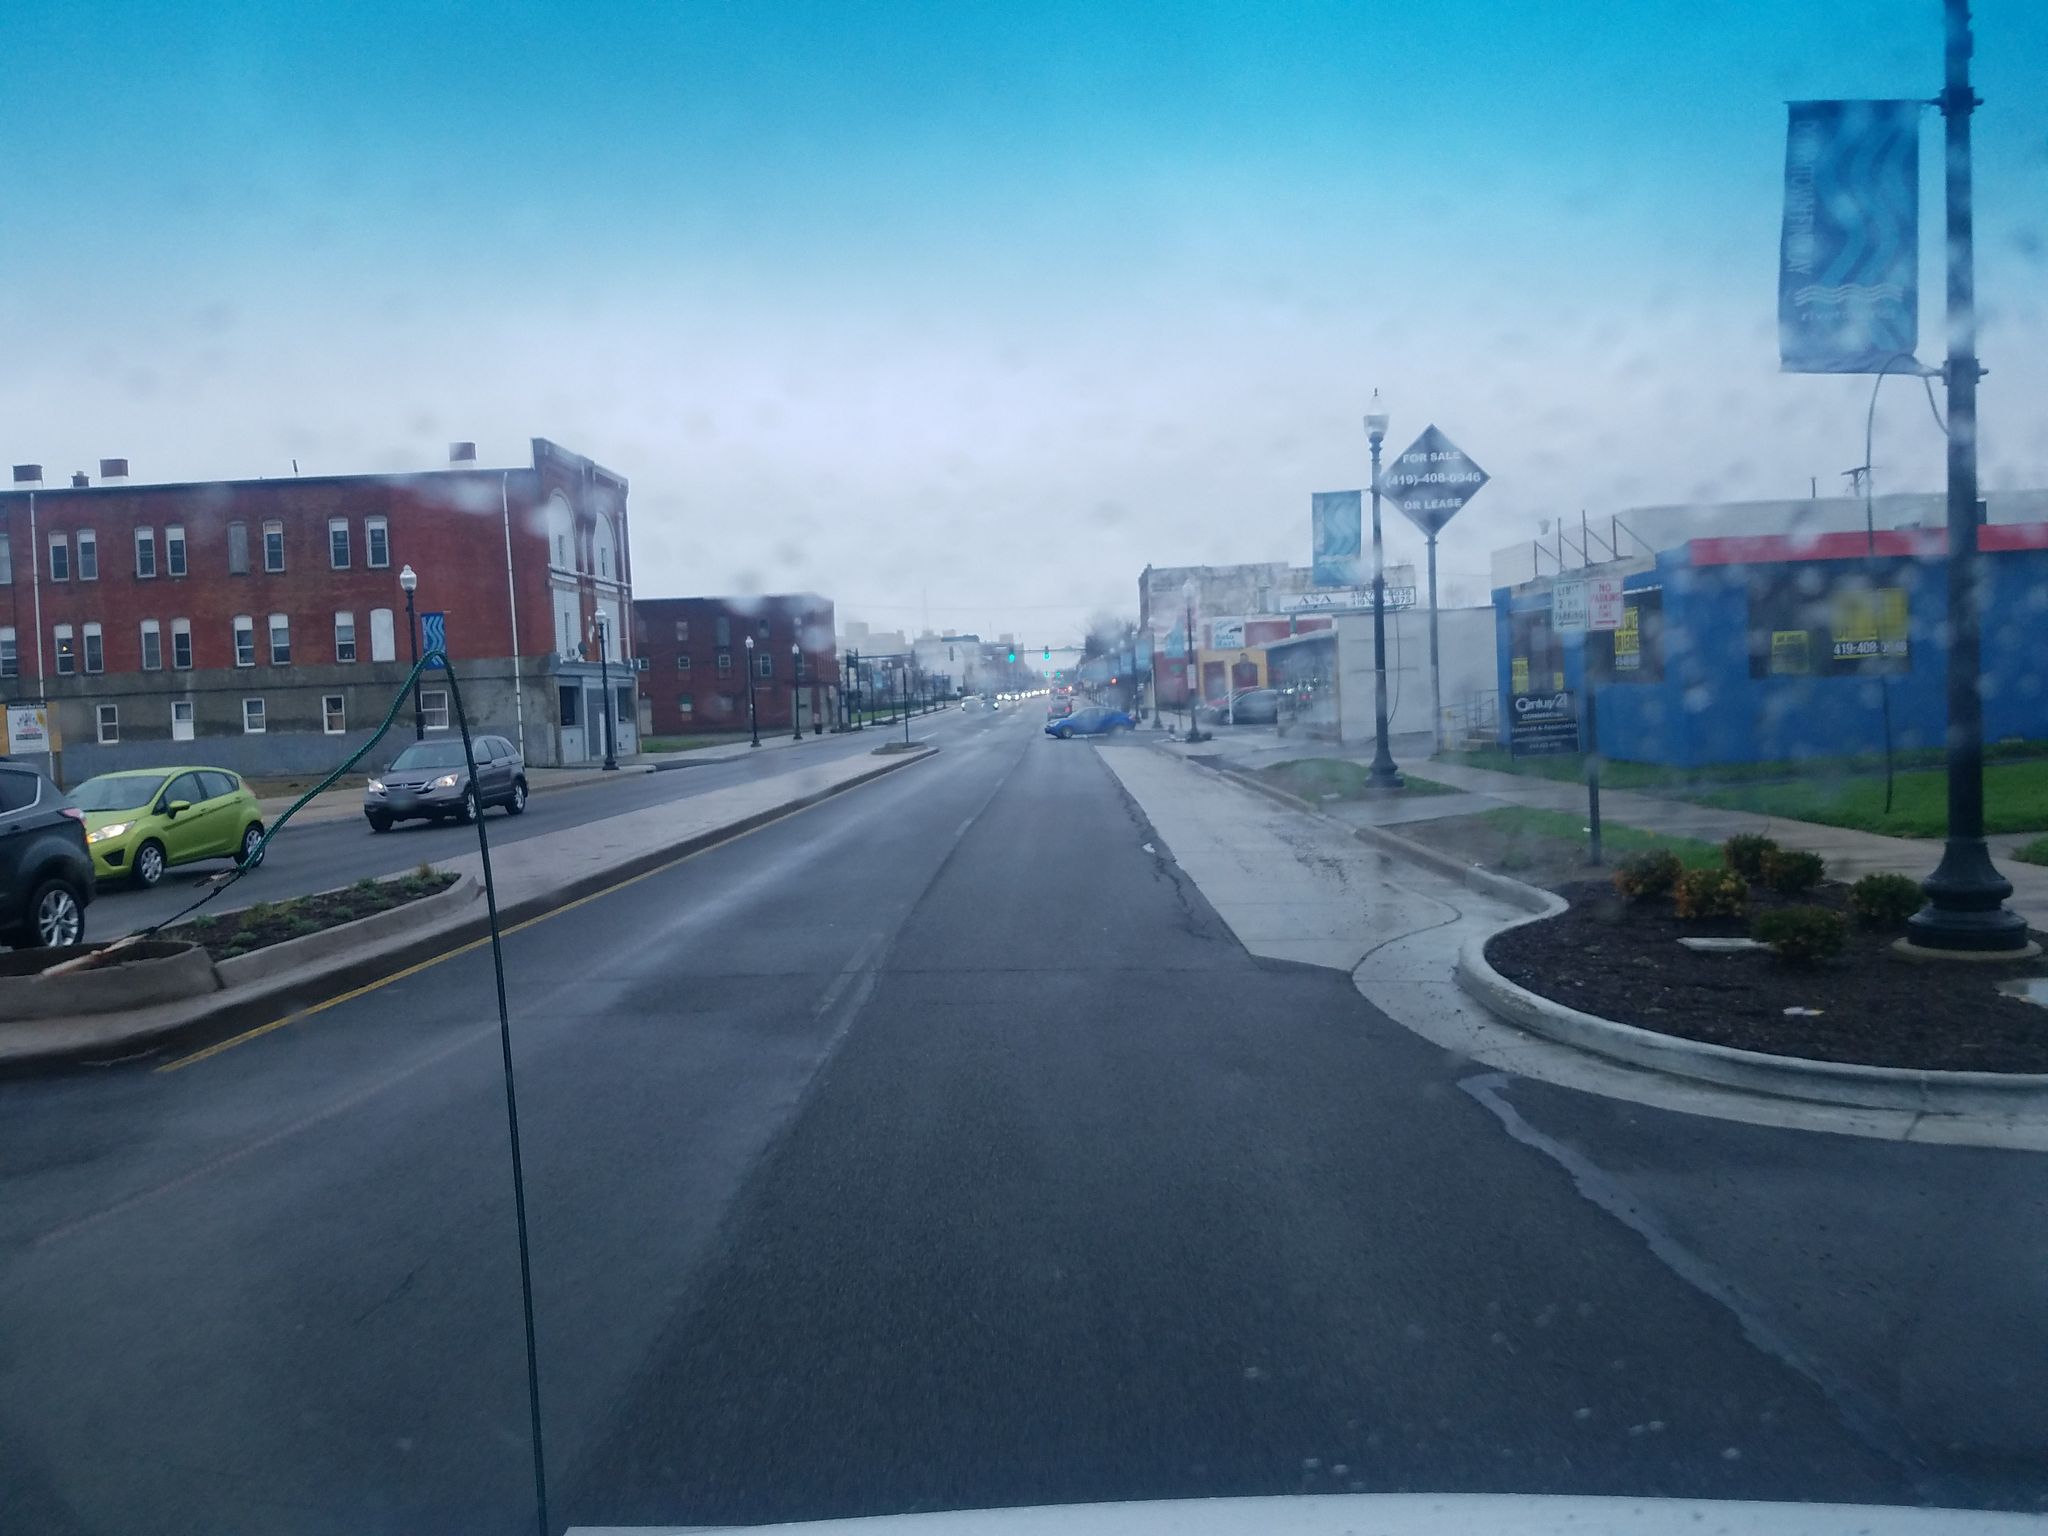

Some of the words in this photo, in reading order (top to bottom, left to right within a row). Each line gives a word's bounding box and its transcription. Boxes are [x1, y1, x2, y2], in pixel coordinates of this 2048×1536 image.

[1402, 453, 1426, 463] FOR
[1430, 452, 1460, 462] SALE
[1404, 500, 1420, 510] OR
[1424, 498, 1463, 509] LEASE
[1598, 583, 1612, 592] NO
[1515, 697, 1554, 712] Century
[1554, 693, 1568, 707] 21
